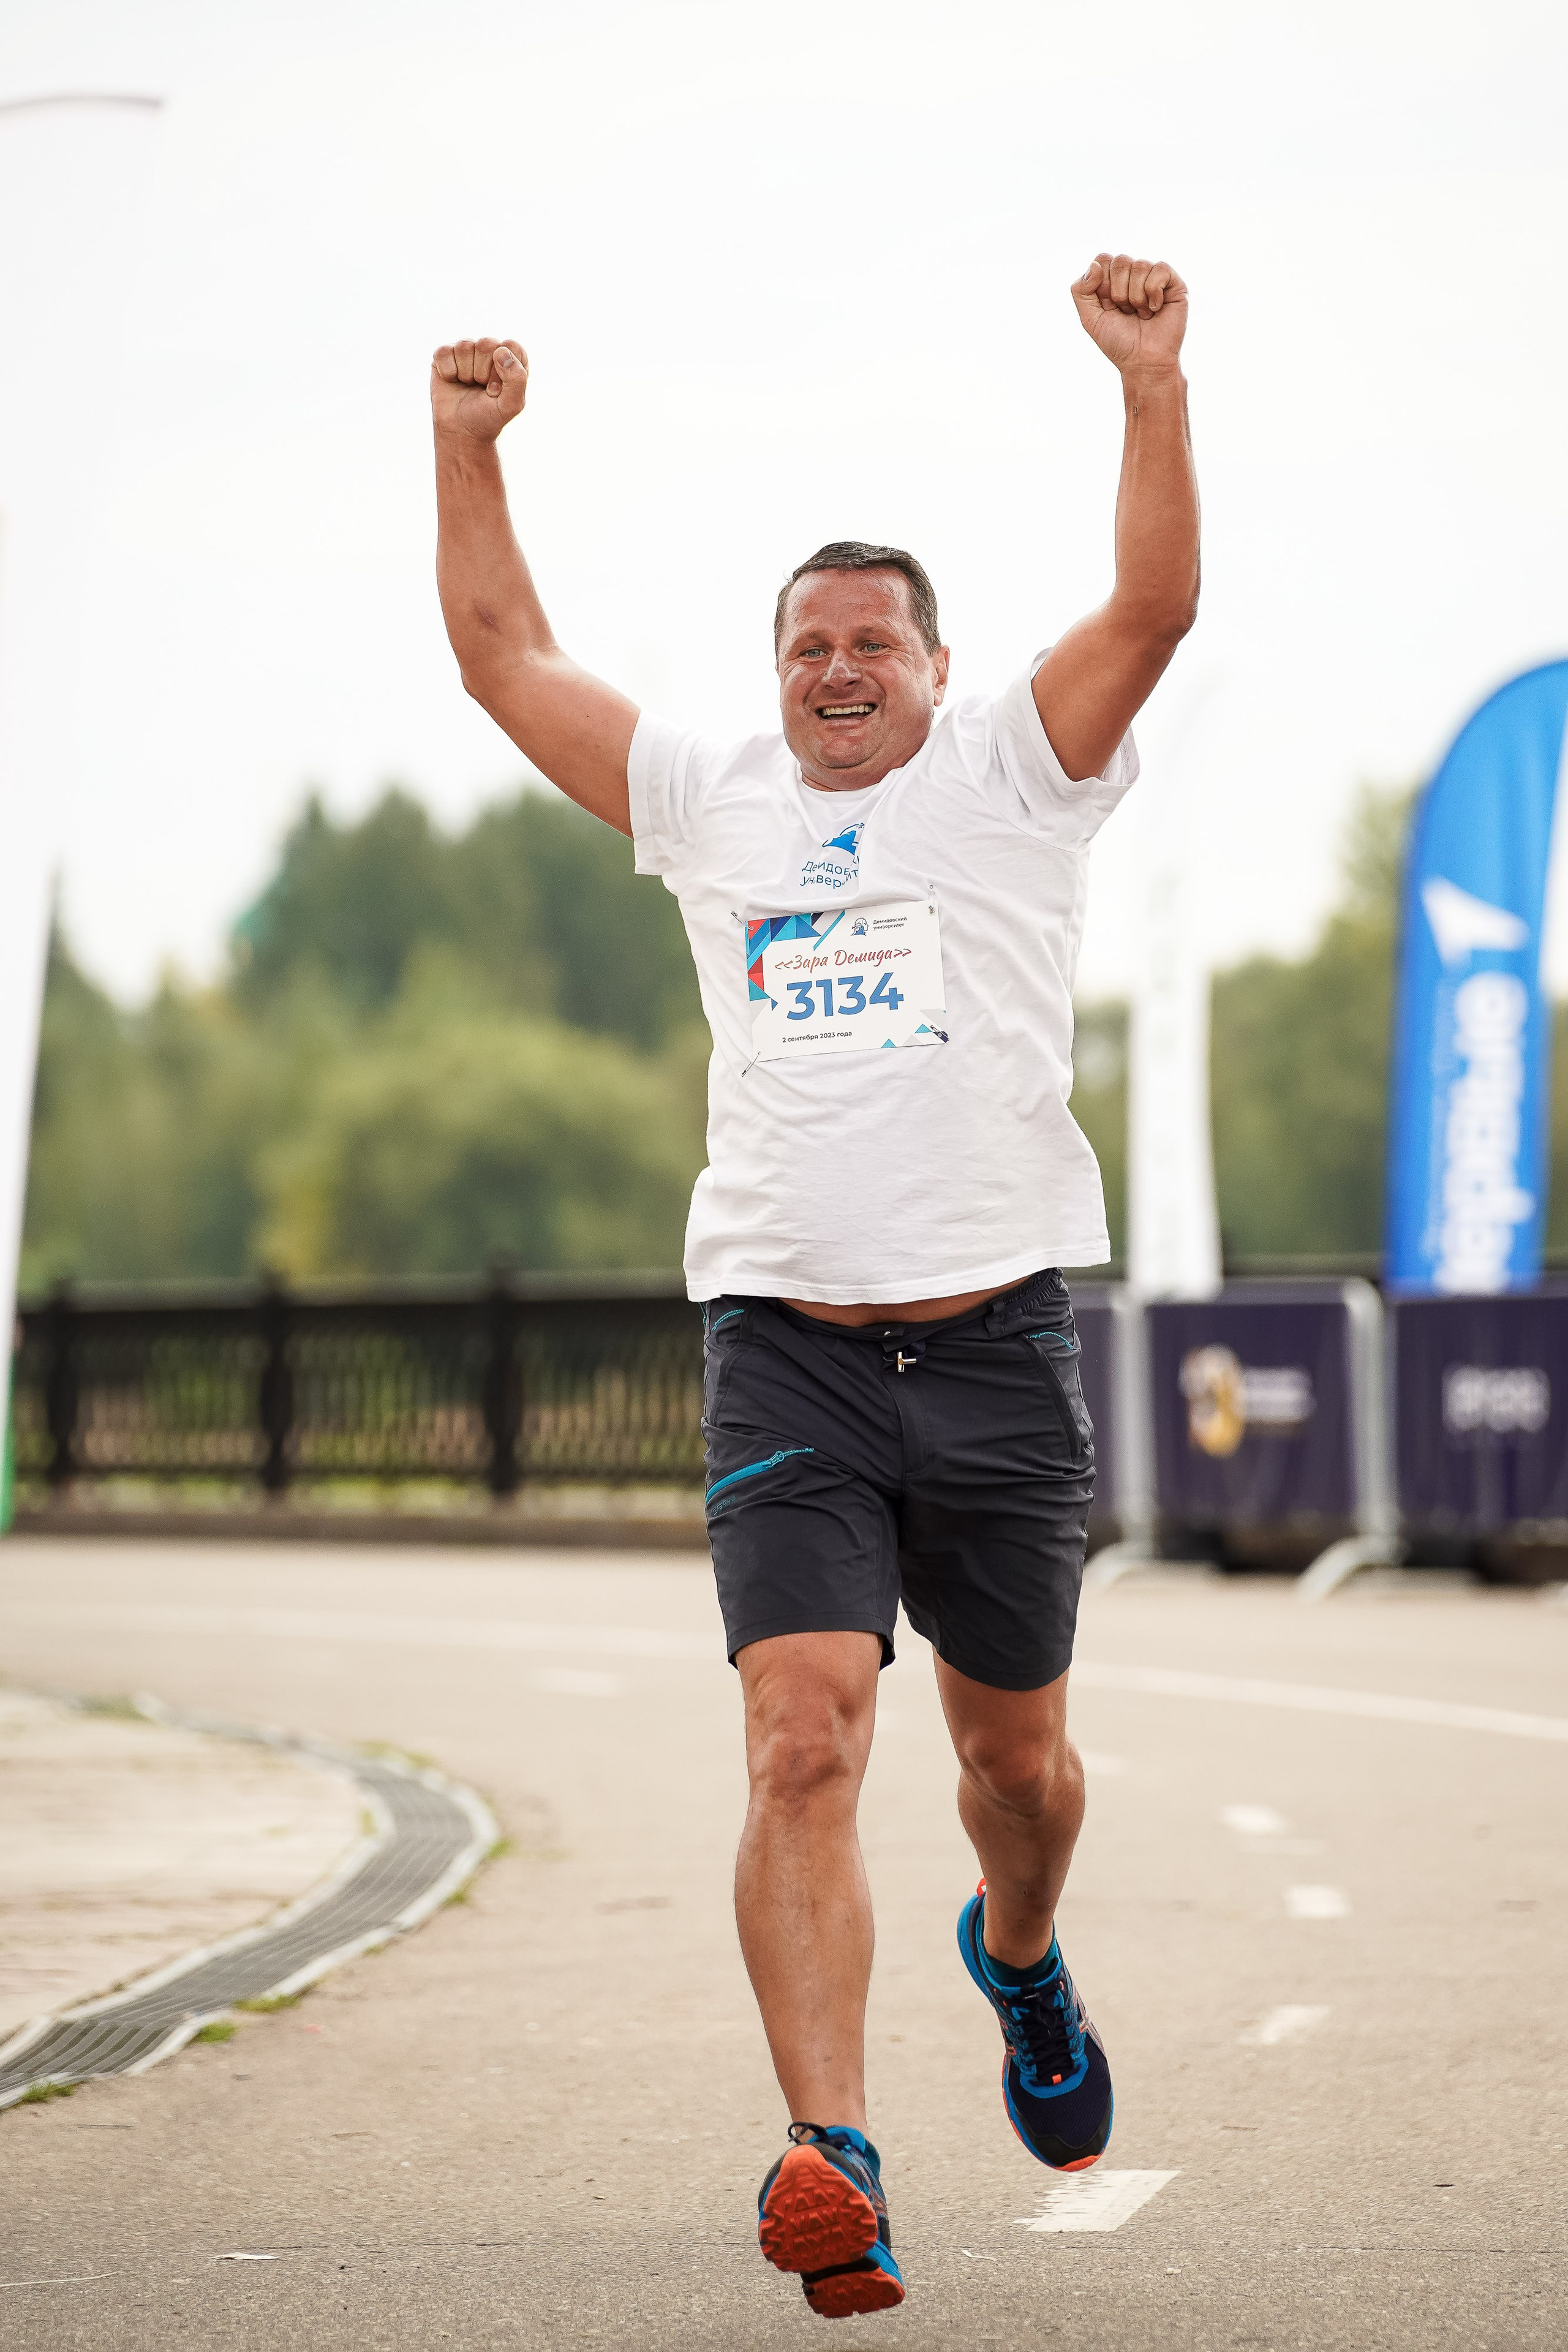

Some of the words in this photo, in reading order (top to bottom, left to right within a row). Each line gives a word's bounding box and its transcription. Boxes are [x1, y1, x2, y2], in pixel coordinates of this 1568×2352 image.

[873, 916, 907, 925] Демидовский
[786, 972, 904, 1020] 3134
[787, 1034, 818, 1042] сентября
